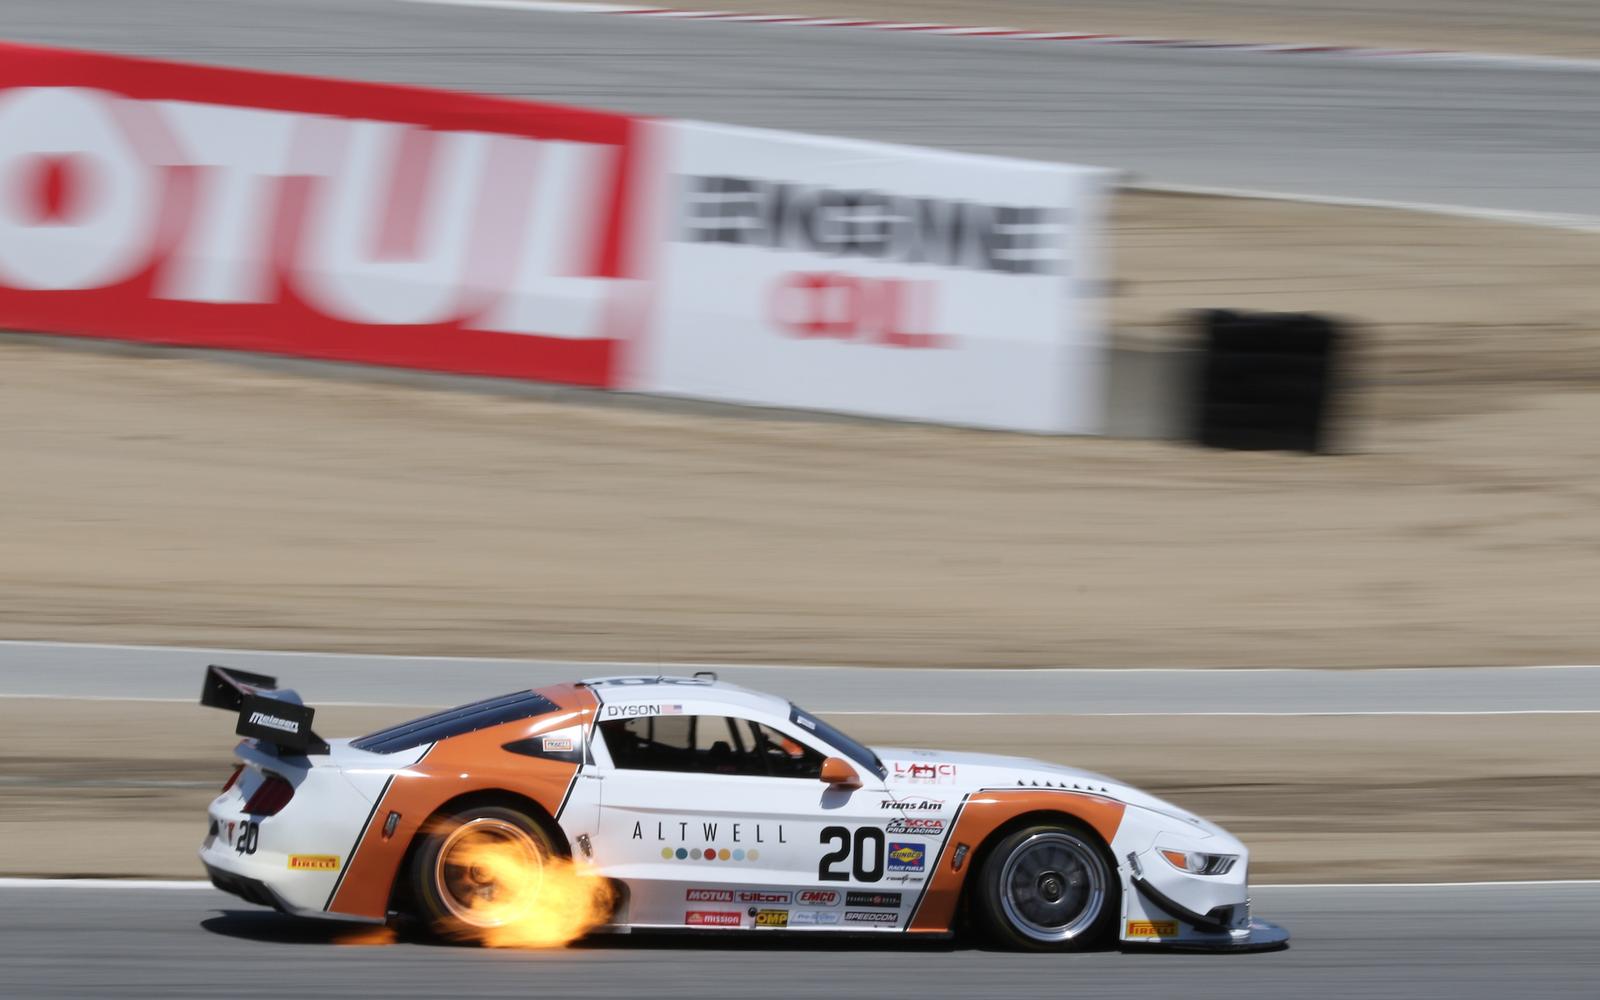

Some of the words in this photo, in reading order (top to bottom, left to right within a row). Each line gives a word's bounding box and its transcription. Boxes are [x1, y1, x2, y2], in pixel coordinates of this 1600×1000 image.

[607, 704, 661, 717] DYSON
[880, 800, 917, 810] Trans
[917, 800, 943, 810] Am
[904, 819, 943, 828] SCCA
[632, 820, 787, 844] ALTWELL
[906, 827, 942, 835] RACING
[235, 819, 259, 855] 20
[818, 826, 885, 883] 20
[291, 857, 336, 868] PIRELLI
[687, 890, 732, 901] MOTUL
[738, 892, 789, 903] tilton
[800, 891, 837, 902] EMCO
[703, 914, 739, 924] mission
[756, 913, 787, 925] OMP
[845, 912, 898, 922] SPEEDCOM
[1129, 922, 1175, 935] PIRELLI
